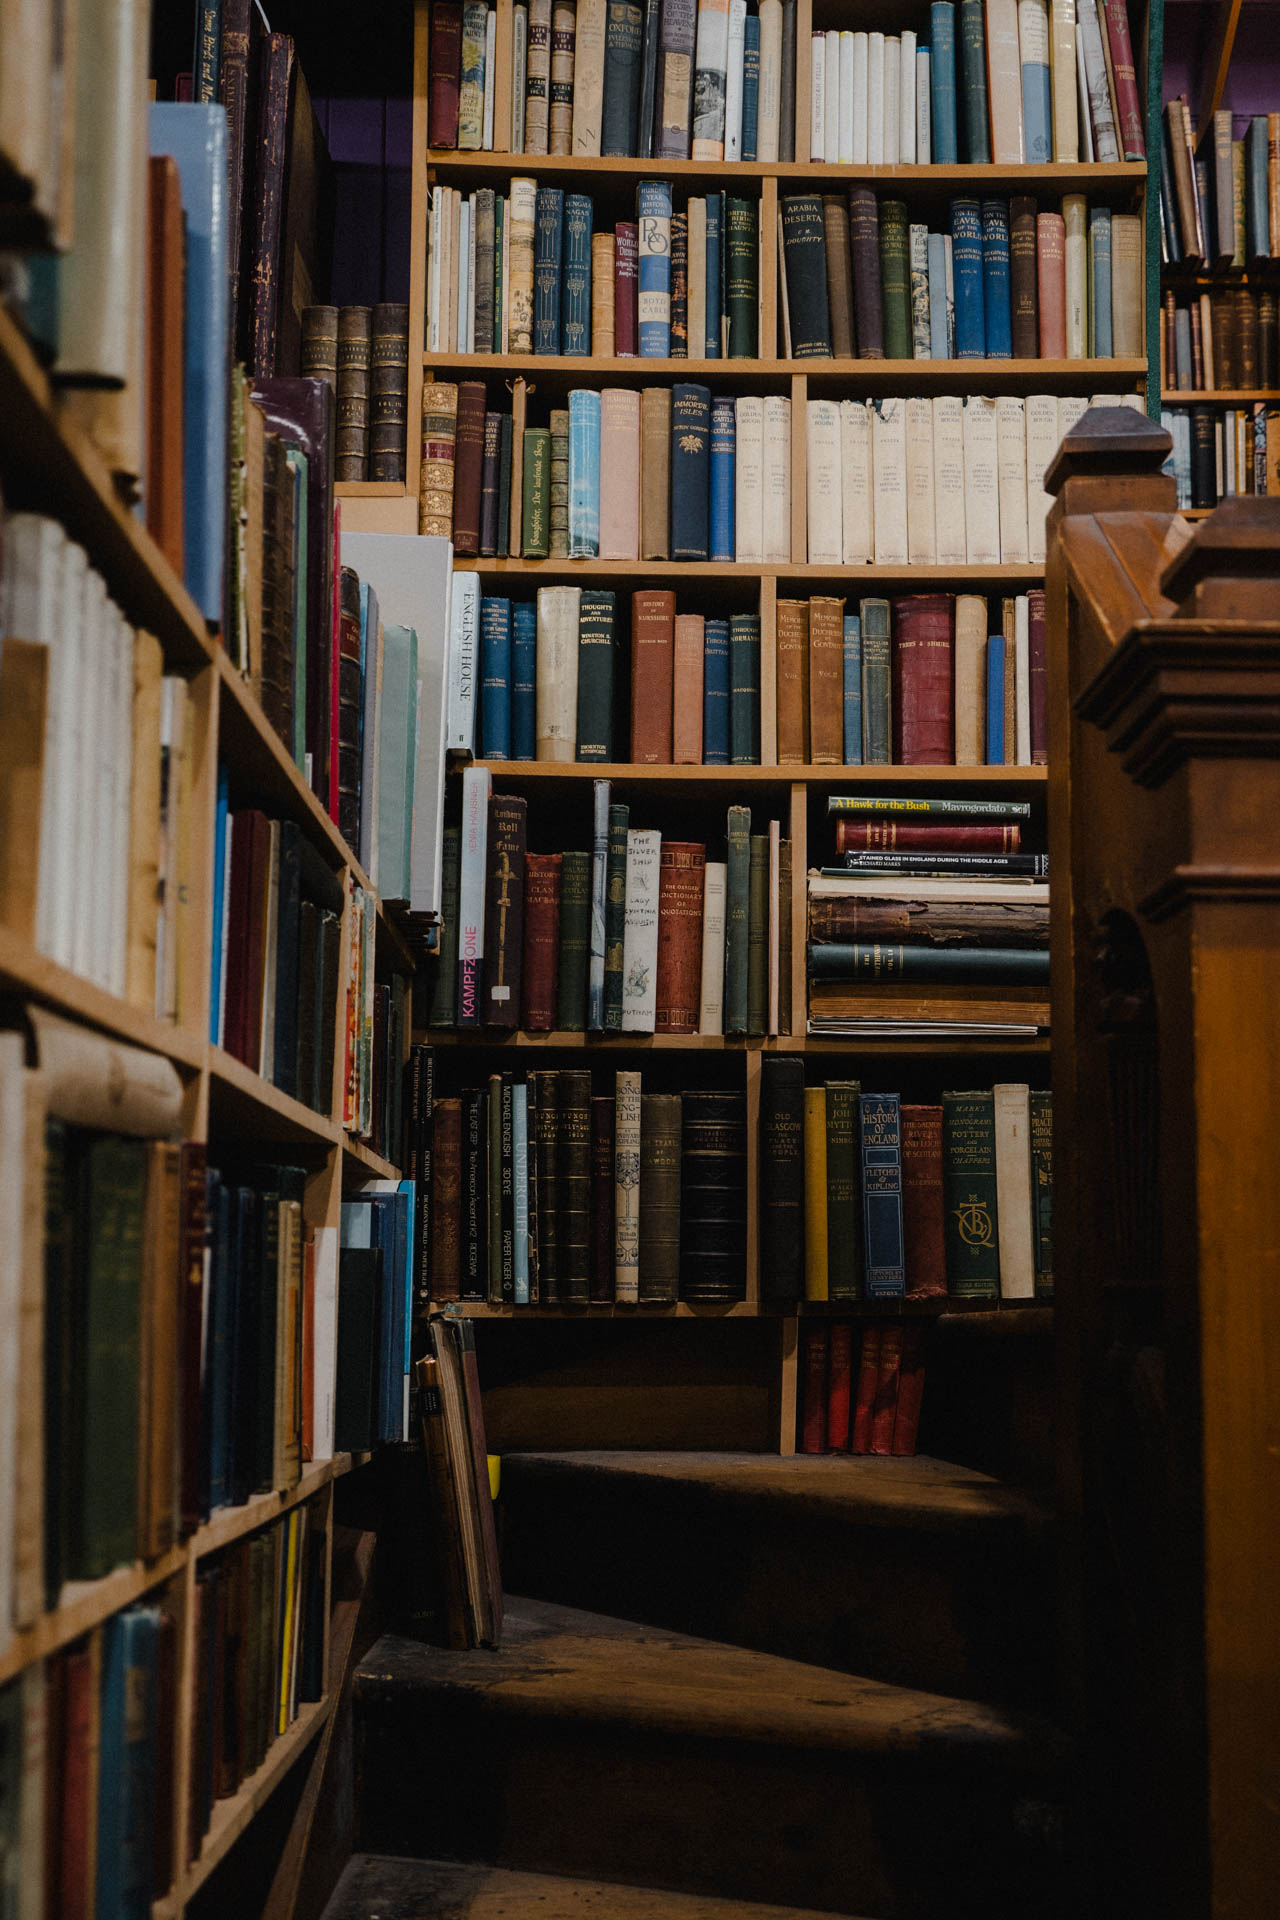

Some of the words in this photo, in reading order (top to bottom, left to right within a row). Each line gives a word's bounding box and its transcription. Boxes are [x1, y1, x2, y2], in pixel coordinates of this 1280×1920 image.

[666, 4, 694, 12] STORY
[204, 8, 216, 32] Some
[667, 11, 680, 19] OF
[681, 12, 694, 20] THE
[664, 18, 696, 28] HEAVENS
[609, 24, 642, 34] OXFORD
[202, 34, 216, 60] Birds
[202, 62, 214, 82] and
[642, 201, 668, 209] HISTORY
[788, 204, 818, 213] ARABIA
[784, 215, 822, 224] DESERTA
[954, 218, 980, 226] EAVES
[786, 236, 822, 246] DOUGHTY
[953, 232, 982, 240] WORLD
[644, 298, 666, 306] BOYD
[642, 306, 668, 314] CABLE
[674, 401, 709, 411] IMMORTAL
[536, 438, 546, 456] Berg
[534, 458, 544, 485] laufende
[534, 488, 542, 506] Der
[814, 612, 841, 622] MEMOIRS
[463, 593, 474, 652] ENGLISH
[460, 656, 472, 702] HOUSE
[835, 799, 844, 808] A
[844, 799, 872, 808] Hawk
[876, 800, 888, 810] for
[890, 801, 904, 810] the
[906, 801, 930, 811] Bush
[942, 802, 1006, 814] Mavrogordato
[497, 821, 518, 833] Roll
[496, 840, 520, 852] Fame
[660, 908, 702, 916] QUOTATIONS
[462, 924, 478, 1018] KAMPFZONE
[616, 1086, 640, 1095] SONG
[834, 1094, 855, 1102] LIFE
[468, 1103, 478, 1114] THE
[503, 1086, 512, 1123] MICHAEL
[616, 1104, 640, 1112] ENG-
[876, 1104, 884, 1113] A
[774, 1112, 790, 1120] OLD
[832, 1110, 854, 1118] JOHN
[864, 1114, 897, 1124] HISTORY
[468, 1114, 478, 1130] LAST
[874, 1124, 886, 1134] OF
[952, 1130, 990, 1138] POTTERY
[468, 1130, 478, 1145] STEP
[503, 1122, 512, 1157] ENGLISH
[864, 1134, 898, 1144] ENGLAND
[908, 1130, 938, 1139] RIVERS
[912, 1150, 942, 1158] SCOTLAND
[950, 1146, 992, 1154] PORCELAIN
[469, 1151, 479, 1162] The
[503, 1167, 512, 1178] 3D
[866, 1168, 898, 1176] FLETCHER
[468, 1162, 479, 1196] American
[503, 1178, 512, 1196] EYE
[516, 1142, 527, 1236] UNDERCLIFF
[468, 1196, 479, 1216] Ascent
[468, 1226, 478, 1238] K2
[503, 1229, 512, 1256] PAPER
[468, 1242, 478, 1278] RIDGEWAY
[503, 1256, 512, 1280] TIGER
